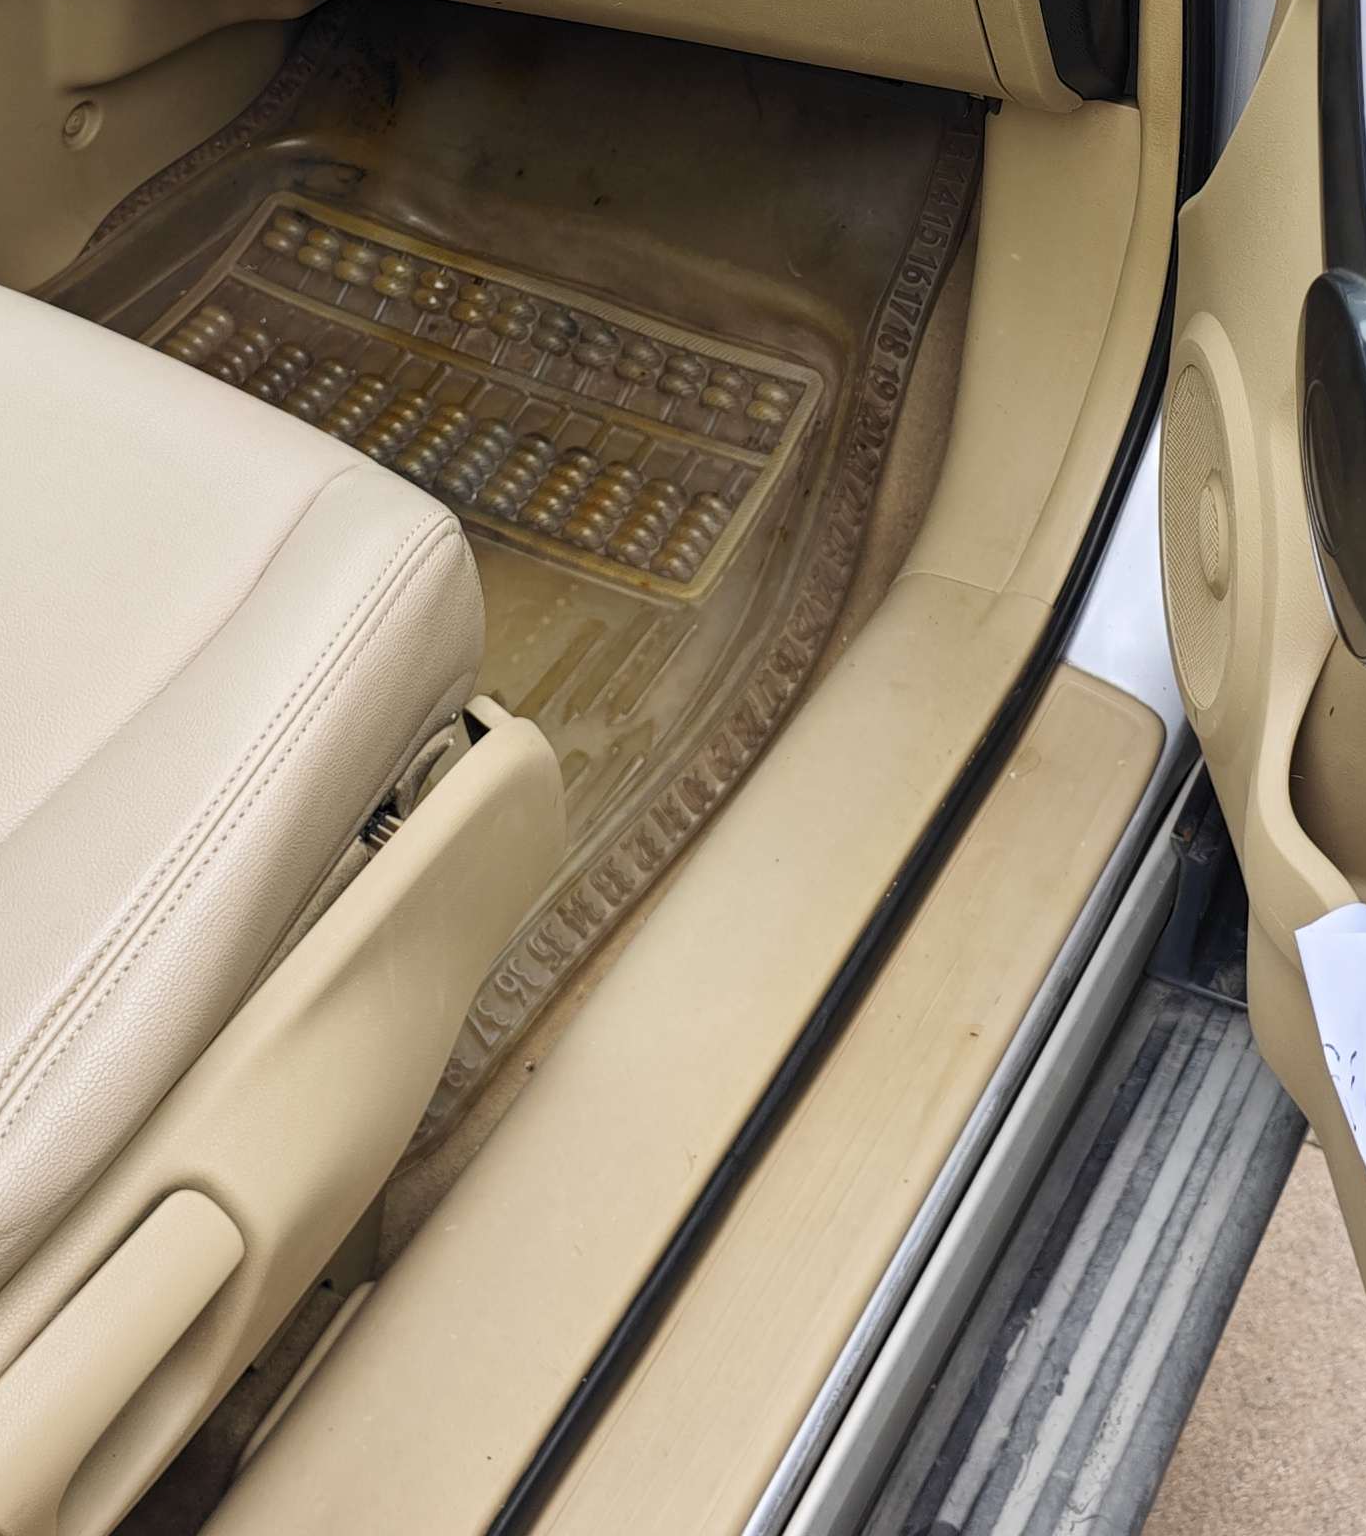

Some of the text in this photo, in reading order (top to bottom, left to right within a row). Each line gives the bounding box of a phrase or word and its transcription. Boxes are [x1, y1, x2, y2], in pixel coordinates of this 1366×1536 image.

[920, 213, 953, 249] 15
[902, 254, 938, 289] 16
[889, 289, 924, 329] 17
[877, 323, 913, 359] 18
[495, 956, 549, 1010] 36
[468, 999, 512, 1047] 37
